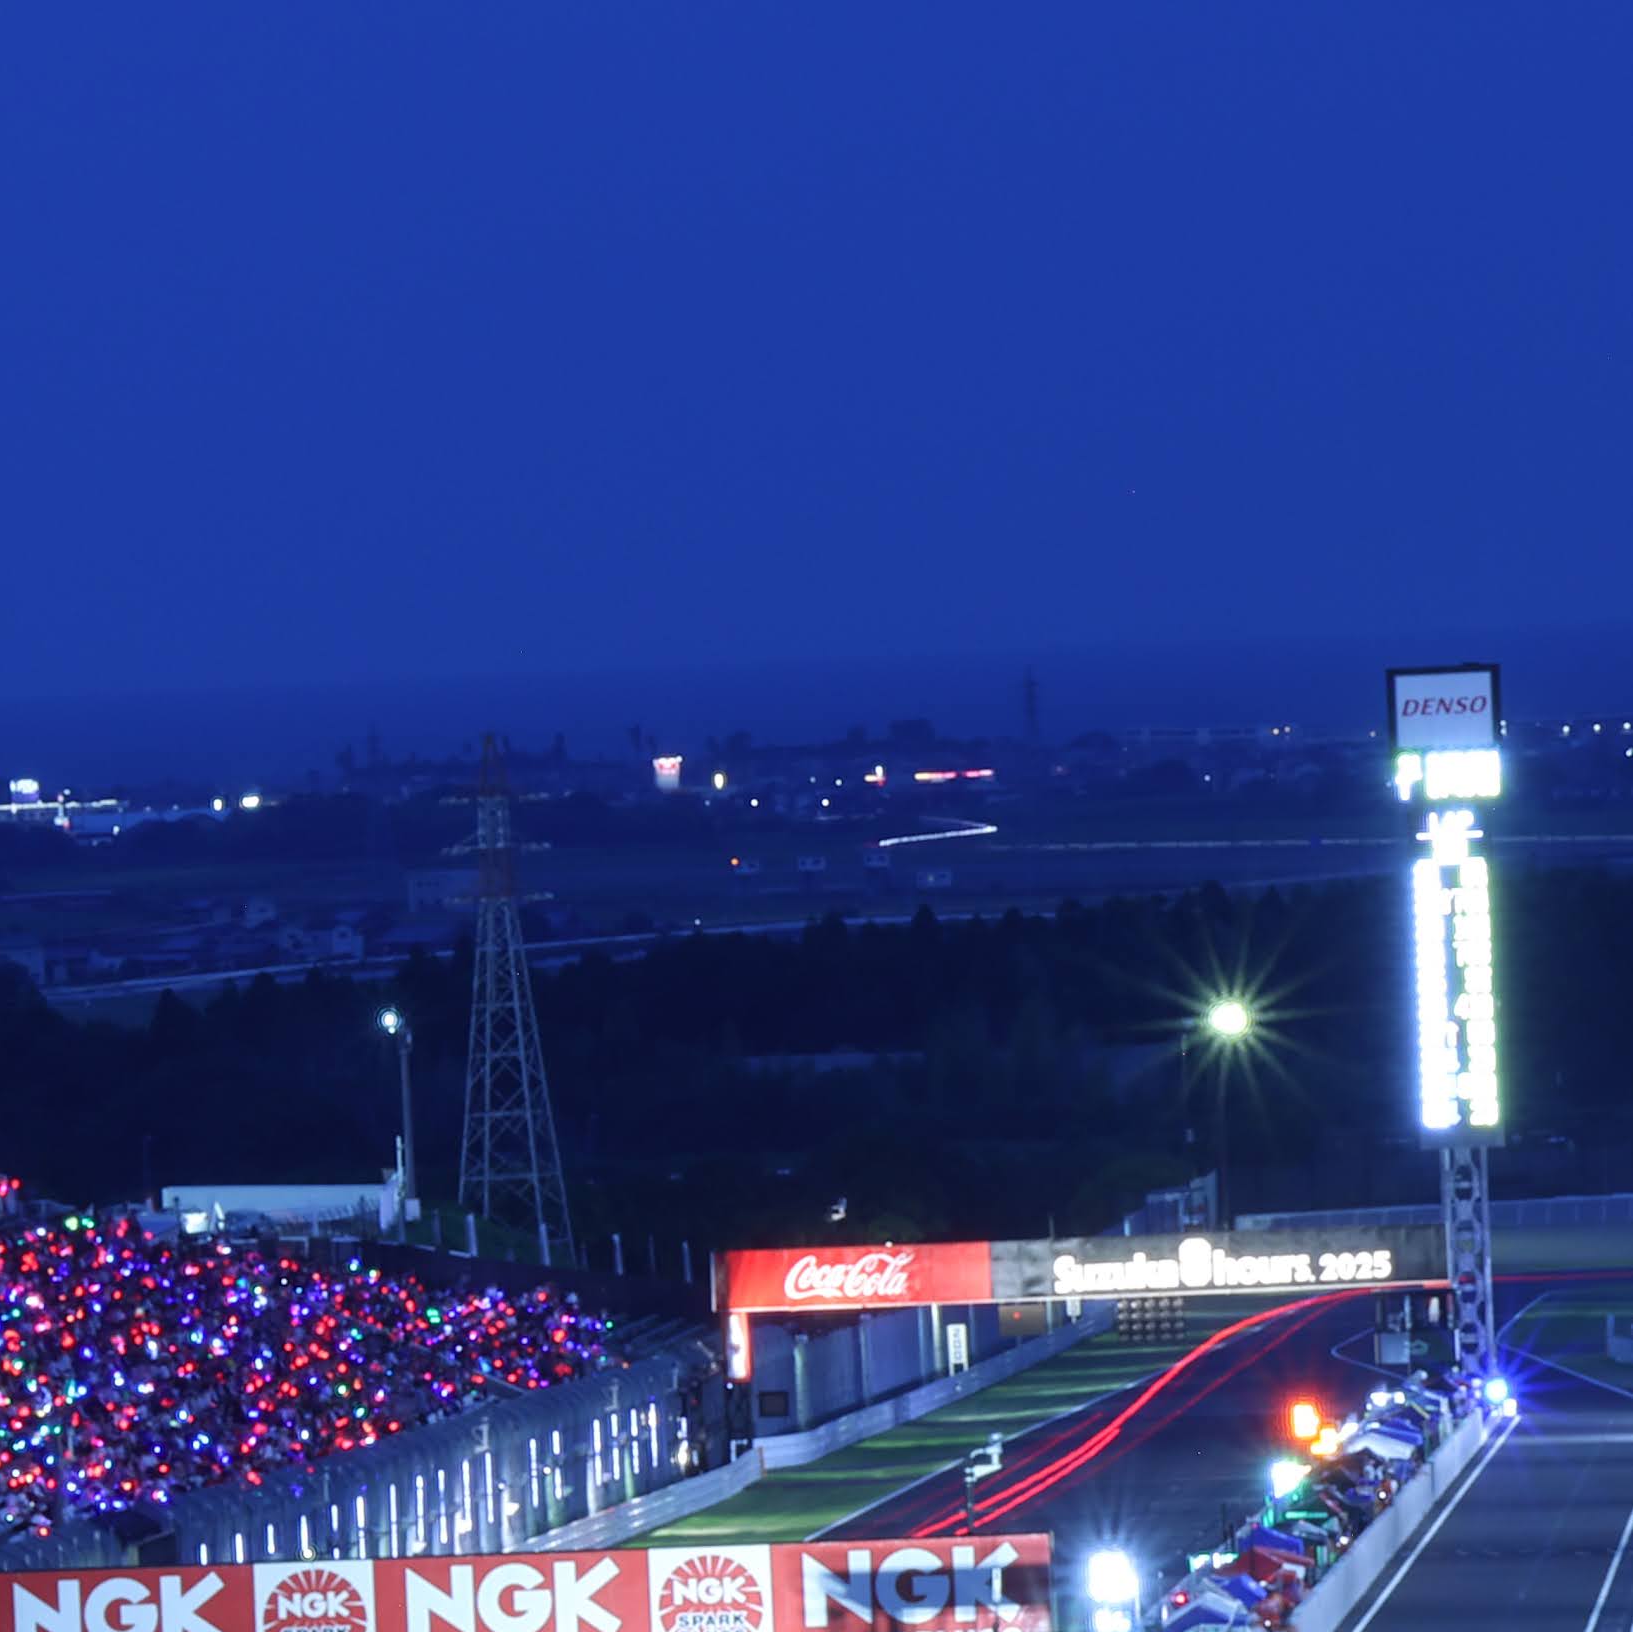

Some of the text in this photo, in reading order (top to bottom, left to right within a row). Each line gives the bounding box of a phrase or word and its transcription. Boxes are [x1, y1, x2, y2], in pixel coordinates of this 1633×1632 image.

[1401, 695, 1488, 717] DENSO
[1318, 1250, 1392, 1281] 2025
[672, 1575, 748, 1606] NGK
[801, 1541, 1022, 1628] NGK
[277, 1590, 351, 1620] NGK
[679, 1613, 744, 1628] SPARK
